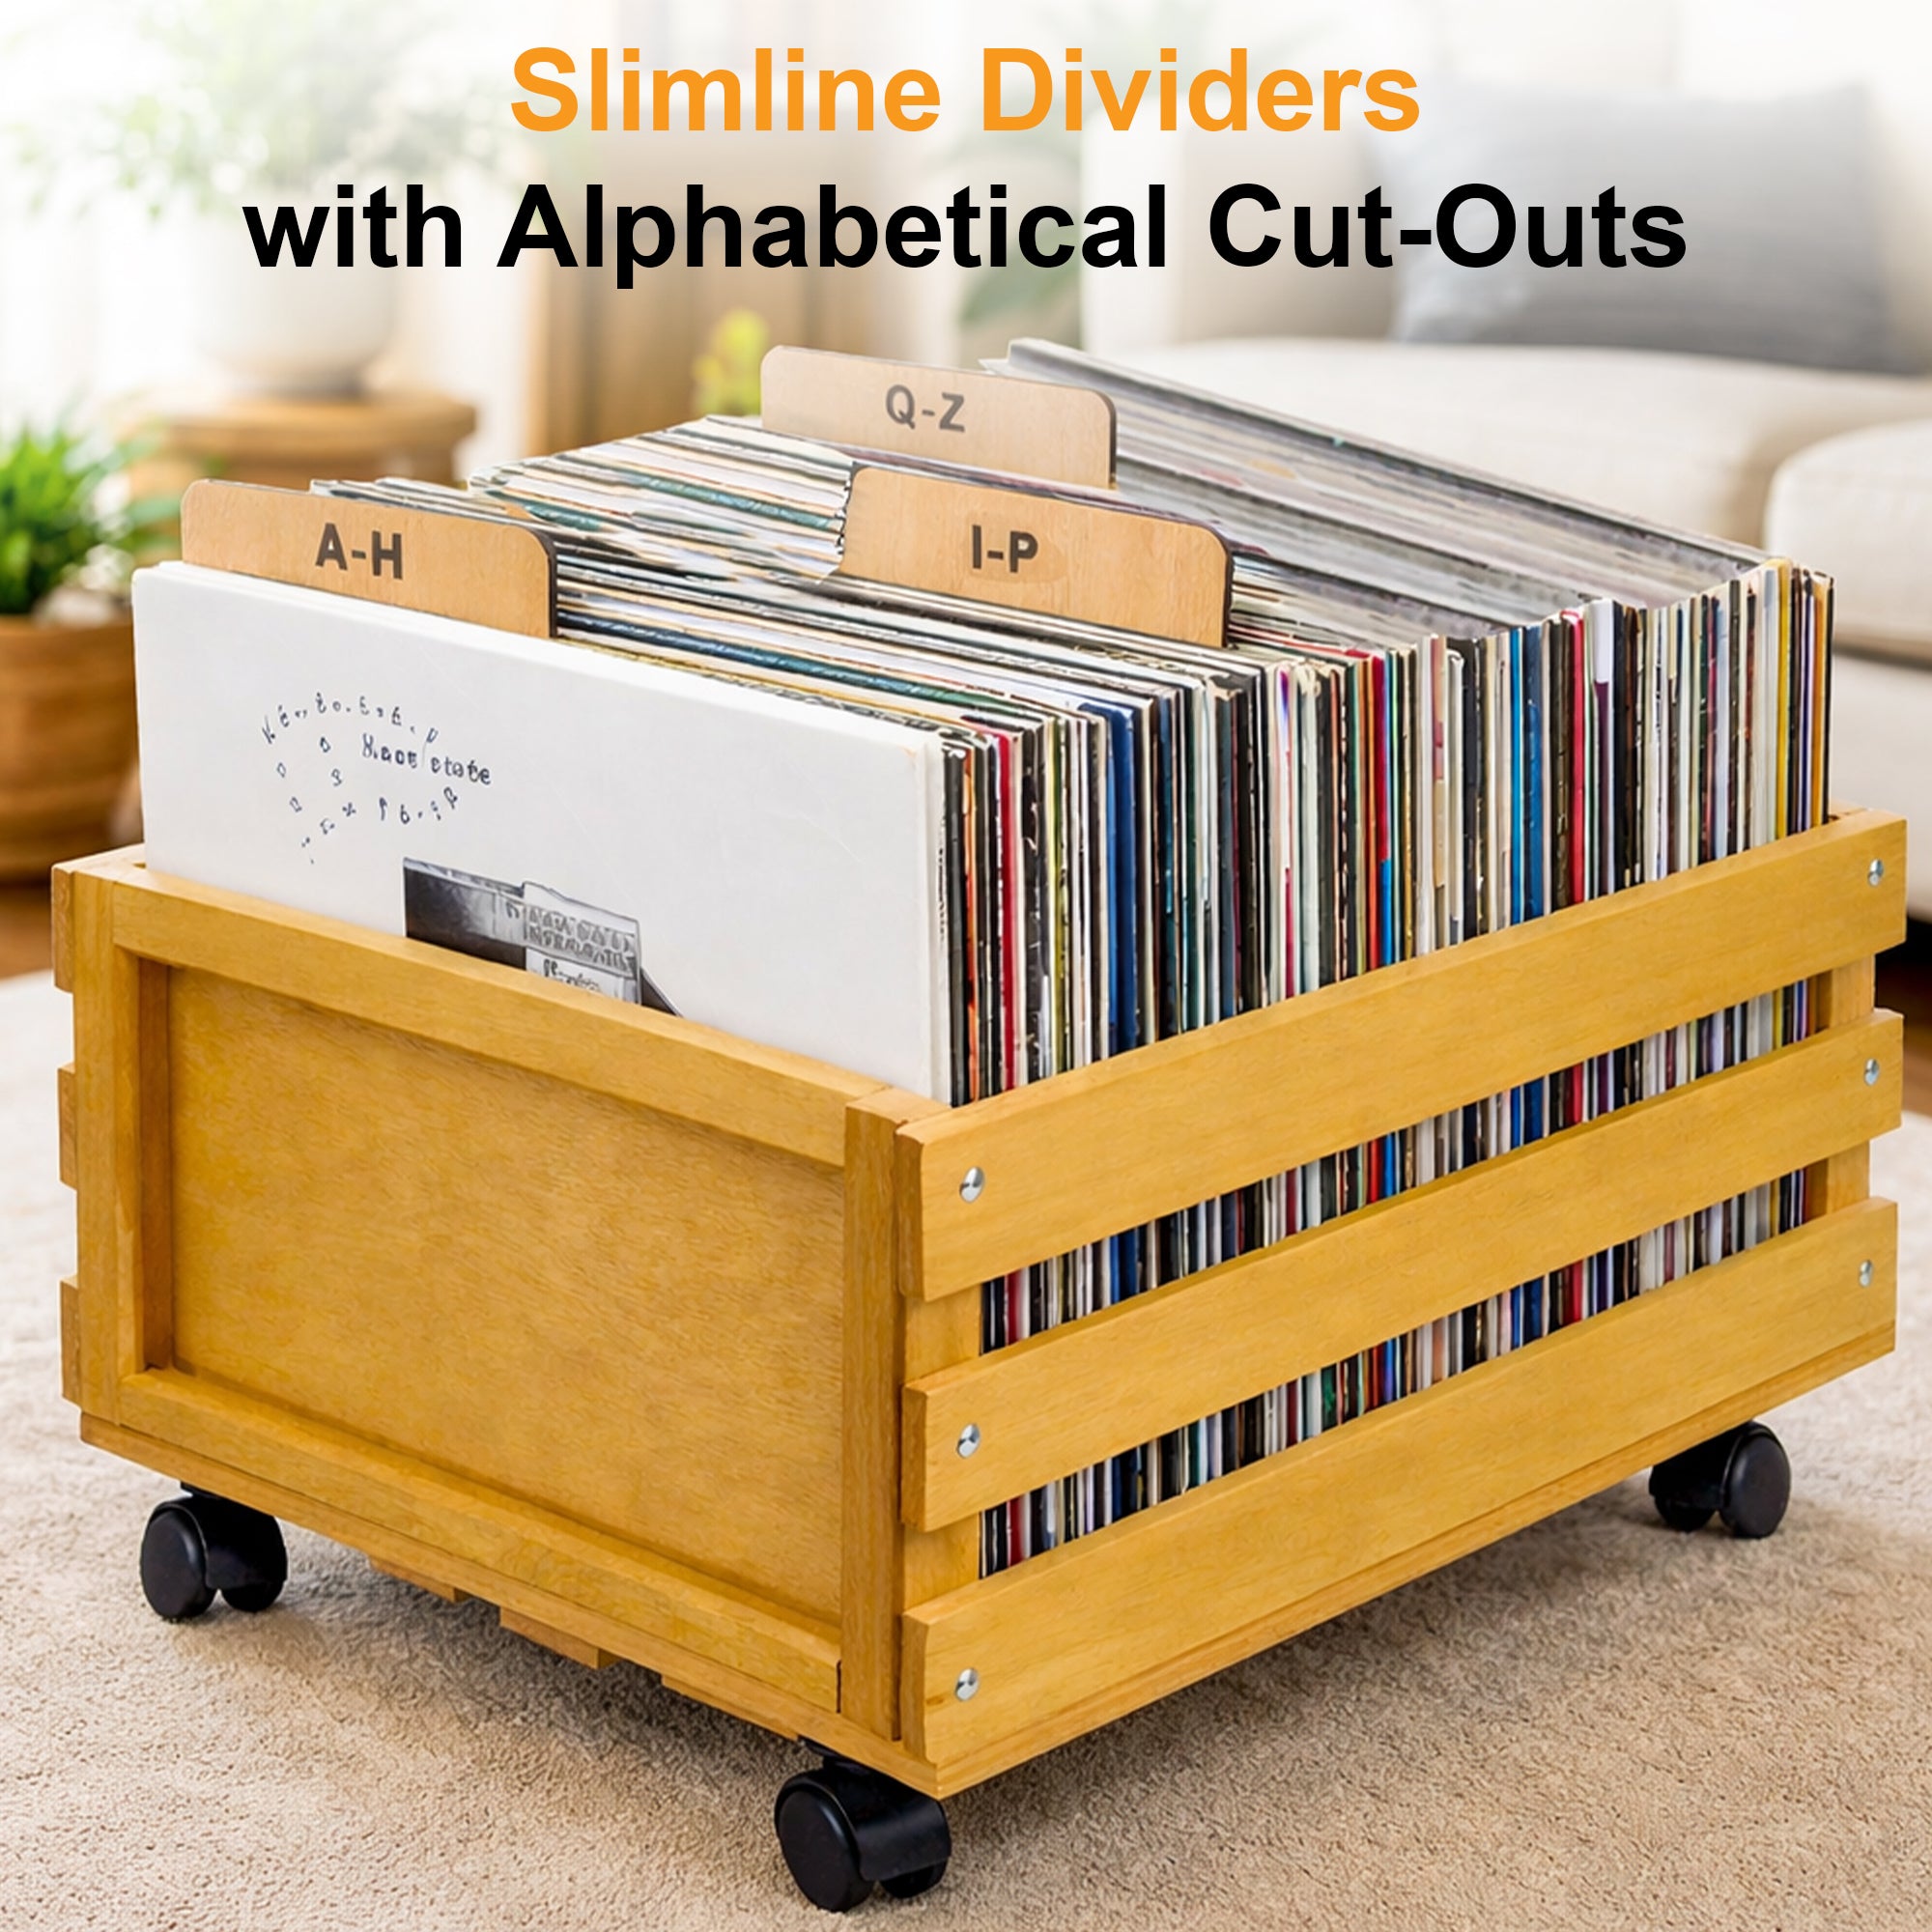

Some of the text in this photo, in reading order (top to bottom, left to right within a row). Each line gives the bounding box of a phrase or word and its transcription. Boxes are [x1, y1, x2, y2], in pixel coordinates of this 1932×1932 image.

[885, 384, 966, 433] Q-Z
[314, 522, 404, 580] A-H
[970, 524, 1039, 574] I-P
